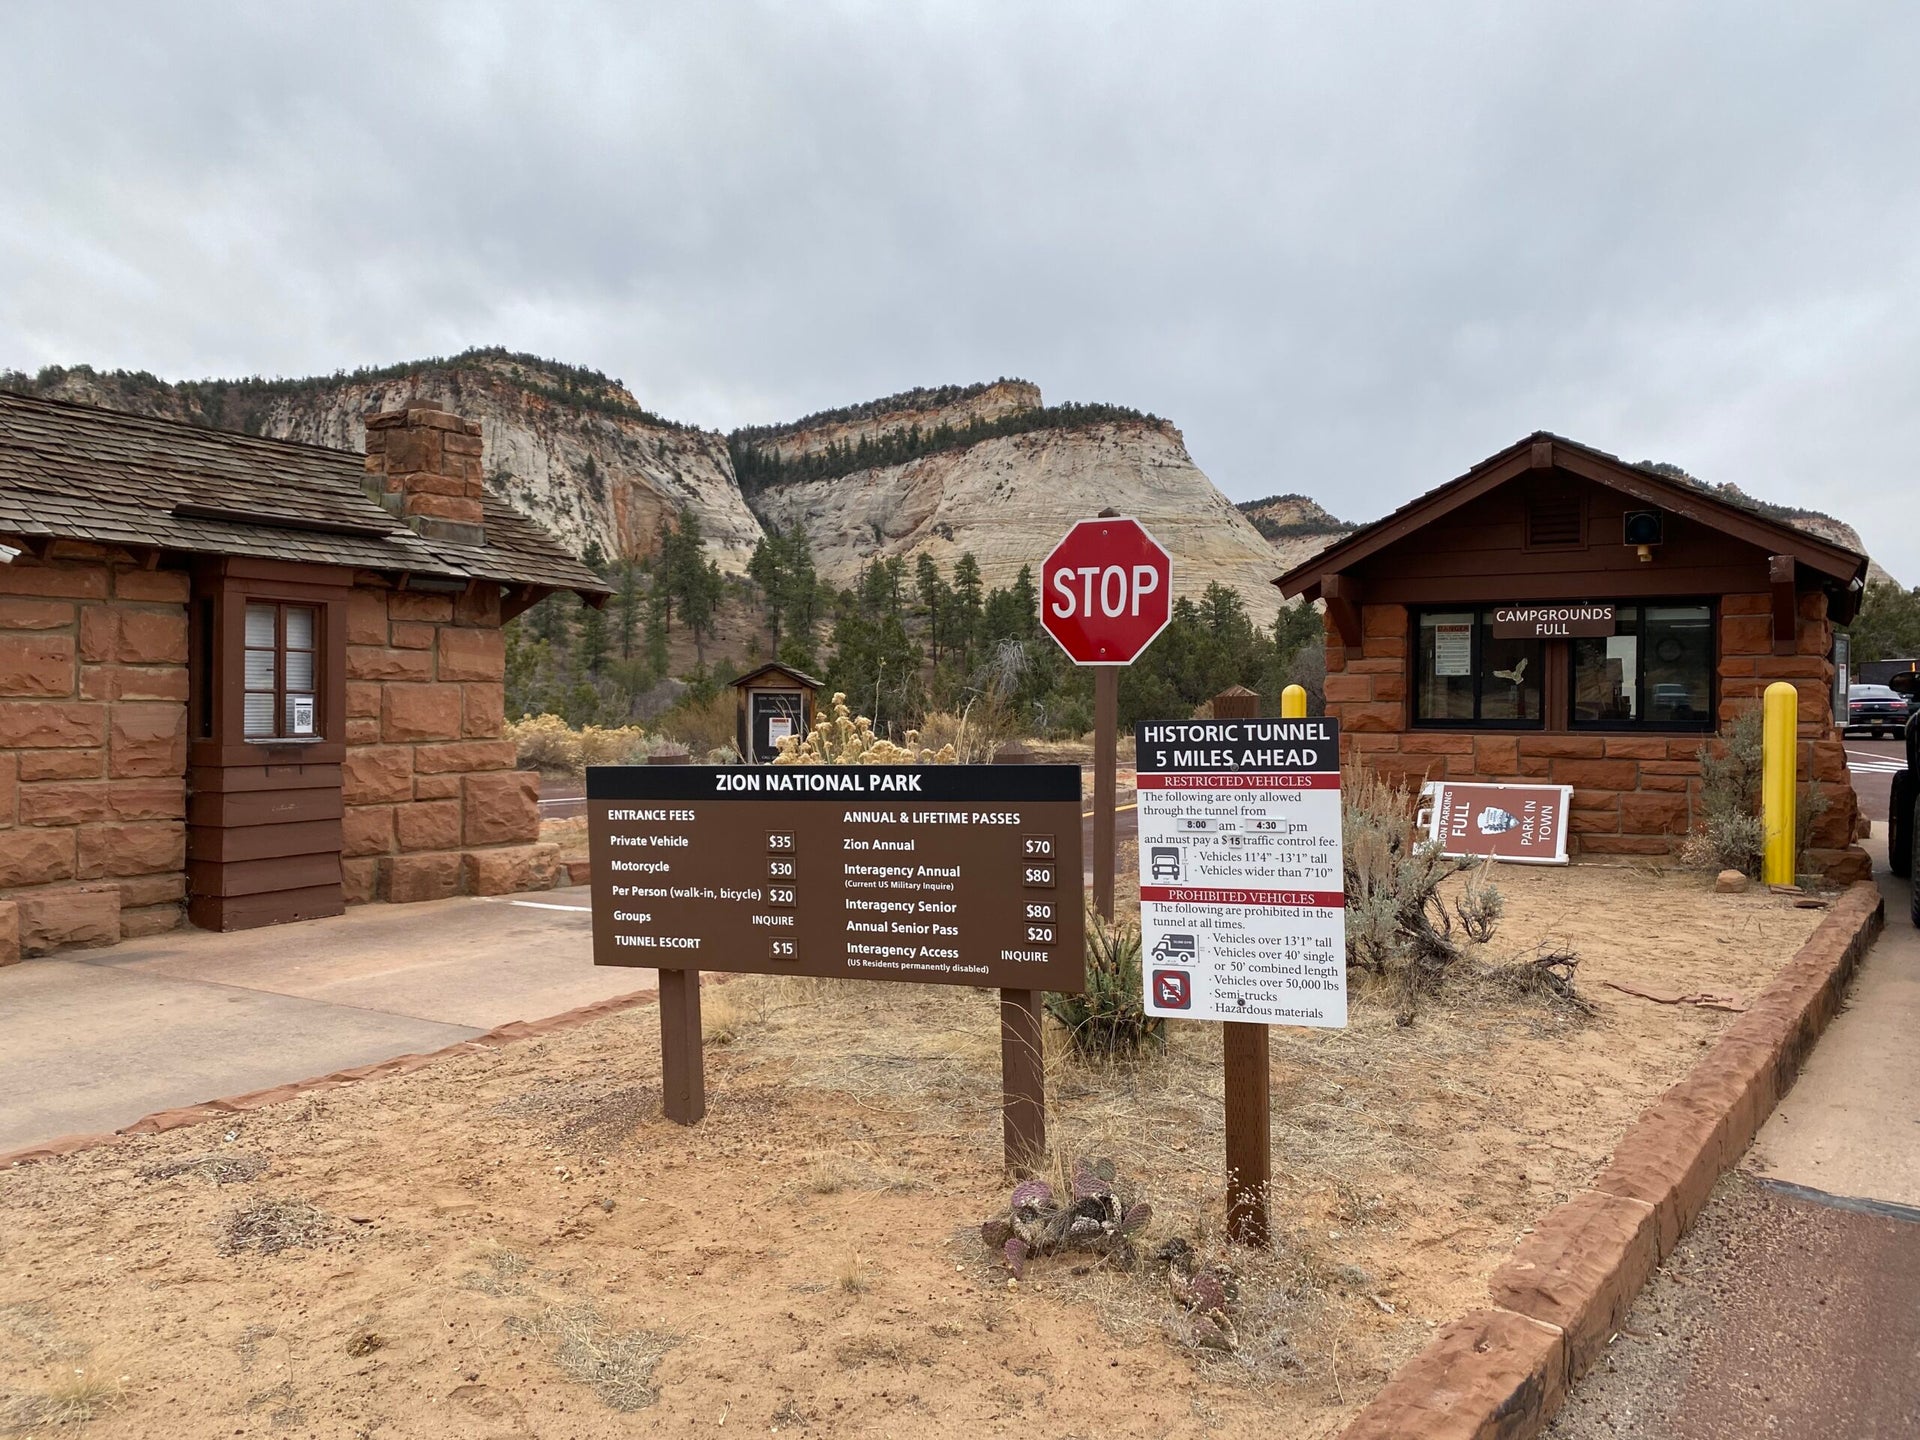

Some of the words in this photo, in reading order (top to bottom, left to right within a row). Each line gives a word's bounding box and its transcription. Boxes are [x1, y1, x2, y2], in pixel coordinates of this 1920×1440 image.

[1052, 565, 1158, 618] STOP
[1496, 608, 1611, 622] CAMPGROUNDS
[1536, 624, 1569, 635] FULL
[1145, 725, 1238, 742] HISTORIC
[1244, 724, 1330, 741] TUNNEL
[1156, 751, 1166, 766] 5
[1174, 750, 1233, 766] MILES
[1241, 750, 1317, 765] AHEAD
[716, 774, 760, 791] ZION
[766, 774, 864, 791] NATIONAL
[870, 774, 922, 791] PARK
[1165, 776, 1243, 786] RESTRICTED
[1246, 776, 1312, 786] VEHICLES
[1143, 792, 1163, 800] The
[1165, 792, 1213, 804] following
[1234, 793, 1257, 804] only
[1260, 792, 1301, 801] allowed
[1144, 806, 1183, 818] through
[1186, 806, 1202, 815] the
[1205, 806, 1238, 815] tunnel
[1240, 806, 1266, 815] from
[1441, 792, 1452, 825] PARKING
[1524, 801, 1536, 812] IN
[608, 810, 666, 820] ENTRANCE
[670, 810, 695, 821] FEES
[844, 812, 896, 823] ANNUAL
[900, 813, 909, 823] &
[913, 812, 968, 824] LIFETIME
[972, 813, 1020, 824] PASSES
[1452, 802, 1470, 836] FULL
[1187, 821, 1206, 829] 8:00
[1219, 823, 1236, 831] am
[1257, 821, 1276, 829] 4:30
[1289, 823, 1307, 834] pm
[1521, 816, 1535, 845] PARK
[1539, 806, 1553, 841] TOWN
[610, 836, 647, 846] Private
[650, 837, 688, 846] Vehicle
[769, 835, 790, 848] $35
[844, 839, 869, 850] Zion
[873, 839, 914, 850] Annual
[1026, 840, 1050, 854] $70
[1144, 835, 1164, 843] and
[1166, 836, 1190, 844] must
[1193, 838, 1210, 846] pay
[1244, 836, 1274, 846] traffic
[1277, 836, 1316, 846] control
[1319, 837, 1338, 846] fee.
[1200, 852, 1241, 861] Vehicles
[1311, 853, 1327, 863] tall
[612, 861, 669, 873] Motorcycle
[771, 862, 792, 875] $30
[845, 864, 913, 878] Interagency
[917, 866, 960, 877] Annual
[1026, 869, 1050, 883] $80
[1200, 865, 1242, 875] Vehicles
[1245, 867, 1274, 876] wider
[1277, 868, 1302, 877] than
[845, 880, 876, 888] (Current
[891, 881, 921, 890] Military
[923, 882, 953, 891] Inquire)
[613, 886, 629, 895] Per
[632, 887, 667, 896] Person
[670, 887, 717, 899] (walk-in,
[721, 889, 761, 901] bicycle)
[770, 890, 792, 902] $20
[1169, 890, 1246, 902] PROHIBITED
[1250, 892, 1315, 904] VEHICLES
[846, 899, 915, 914] Interagency
[918, 901, 957, 913] Senior
[1027, 904, 1050, 918] $80
[1153, 903, 1173, 912] The
[1175, 904, 1223, 916] following
[1226, 907, 1241, 915] are
[1244, 906, 1300, 918] prohibited
[1303, 908, 1313, 917] in
[1316, 909, 1333, 918] the
[614, 910, 651, 923] Groups
[752, 916, 794, 926] INQUIRE
[1153, 918, 1185, 927] tunnel
[1188, 919, 1198, 927] at
[1200, 919, 1212, 928] all
[1214, 920, 1245, 929] times.
[846, 921, 888, 932] Annual
[892, 922, 929, 934] Senior
[933, 923, 958, 935] Pass
[1028, 927, 1052, 941] $20
[615, 936, 657, 947] TUNNEL
[660, 937, 700, 948] ESCORT
[1213, 933, 1255, 944] Vehicles
[1258, 937, 1282, 945] over
[1315, 937, 1332, 947] tall
[847, 943, 916, 958] Interagency
[920, 946, 959, 958] Access
[1001, 950, 1048, 962] INQUIRE
[1214, 947, 1256, 958] Vehicles
[1259, 951, 1282, 959] over
[1303, 952, 1334, 963] single
[848, 958, 861, 967] (US
[863, 960, 899, 968] Residents
[901, 962, 950, 972] permanently
[953, 964, 989, 974] disabled)
[1214, 963, 1225, 971] or
[1248, 964, 1301, 975] combined
[1304, 966, 1338, 978] length
[1214, 975, 1257, 986] Vehicles
[1260, 980, 1283, 988] over
[1286, 979, 1320, 990] 50,000
[1323, 981, 1339, 990] lbs
[1215, 989, 1277, 1002] Semi-trucks
[1215, 1004, 1272, 1015] Hazardous
[1275, 1007, 1323, 1018] materials
